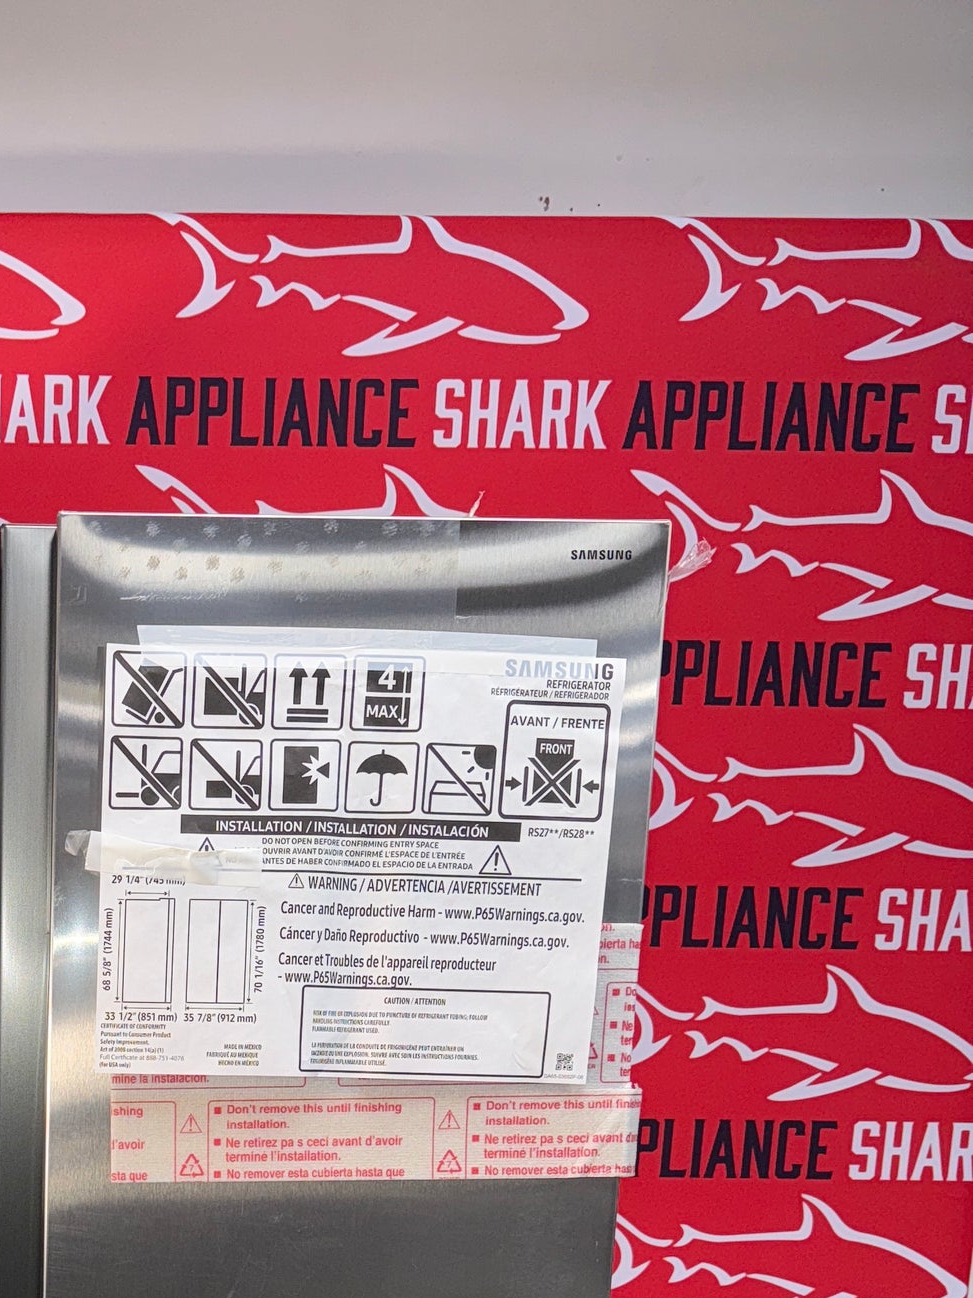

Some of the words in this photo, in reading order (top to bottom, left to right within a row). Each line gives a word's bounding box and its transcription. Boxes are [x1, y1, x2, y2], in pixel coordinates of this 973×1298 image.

[125, 375, 419, 449] APPLIANCE
[432, 378, 612, 451] SHARK
[622, 380, 921, 454] APPLIANCE
[570, 549, 632, 560] SAMSUNG
[505, 658, 614, 680] SAMSUNG
[660, 640, 892, 708] PLIANCE
[377, 664, 396, 691] 4
[546, 679, 611, 690] REFRIGERATOR
[554, 690, 609, 700] REFRIGERADOR
[365, 704, 398, 719] MAX
[511, 716, 550, 727] AVANT
[561, 718, 605, 729] FRENTE
[540, 743, 573, 755] FRONT
[215, 820, 302, 833] INSTALLATION
[314, 822, 397, 835] INSTALLATION
[408, 823, 489, 838] INSTALACIÓN
[314, 838, 339, 846] BEFORE
[341, 839, 388, 848] CONFIRMING
[390, 840, 414, 848] ENTRY
[416, 841, 439, 849] SPACE
[420, 851, 430, 859] DE
[324, 858, 370, 868] CONFIRMADO
[372, 860, 381, 868] EL
[382, 860, 414, 868] ESPACIO
[416, 861, 426, 869] DE
[437, 862, 473, 870] ENTRADA
[112, 875, 123, 884] 29
[308, 875, 357, 891] WARNING
[367, 878, 445, 894] ADVERTENCIA
[280, 901, 317, 915] Cancer
[318, 902, 335, 916] and
[336, 903, 405, 920] Reproductive
[408, 905, 436, 918] Harm
[444, 907, 585, 924] www.P65Warnings.ca.gov.
[642, 884, 864, 951] PLIANCE
[873, 887, 973, 953] SHA
[279, 926, 316, 941] Cáncer
[316, 930, 323, 944] y
[324, 928, 347, 942] Daño
[349, 929, 419, 947] Reproductivo
[430, 932, 569, 950] www.P65Warnings.ca.gov.
[278, 952, 313, 966] Cancer
[314, 955, 323, 967] et
[325, 953, 364, 968] Troubles
[366, 954, 379, 968] de
[381, 954, 429, 972] l'appareil
[431, 956, 497, 975] reproducteur
[285, 971, 412, 988] www.P65Warnings.ca.gov.
[384, 997, 410, 1005] CAUTION
[105, 1012, 115, 1021] 33
[158, 1013, 177, 1022] mm)
[183, 1013, 194, 1022] 35
[237, 1014, 257, 1024] mm)
[486, 1100, 516, 1110] Don't
[519, 1101, 560, 1110] remove
[563, 1100, 584, 1110] this
[587, 1099, 613, 1109] until
[485, 1115, 549, 1126] installation.
[637, 1119, 838, 1180] PLIANCE
[848, 1120, 973, 1183] SHAR
